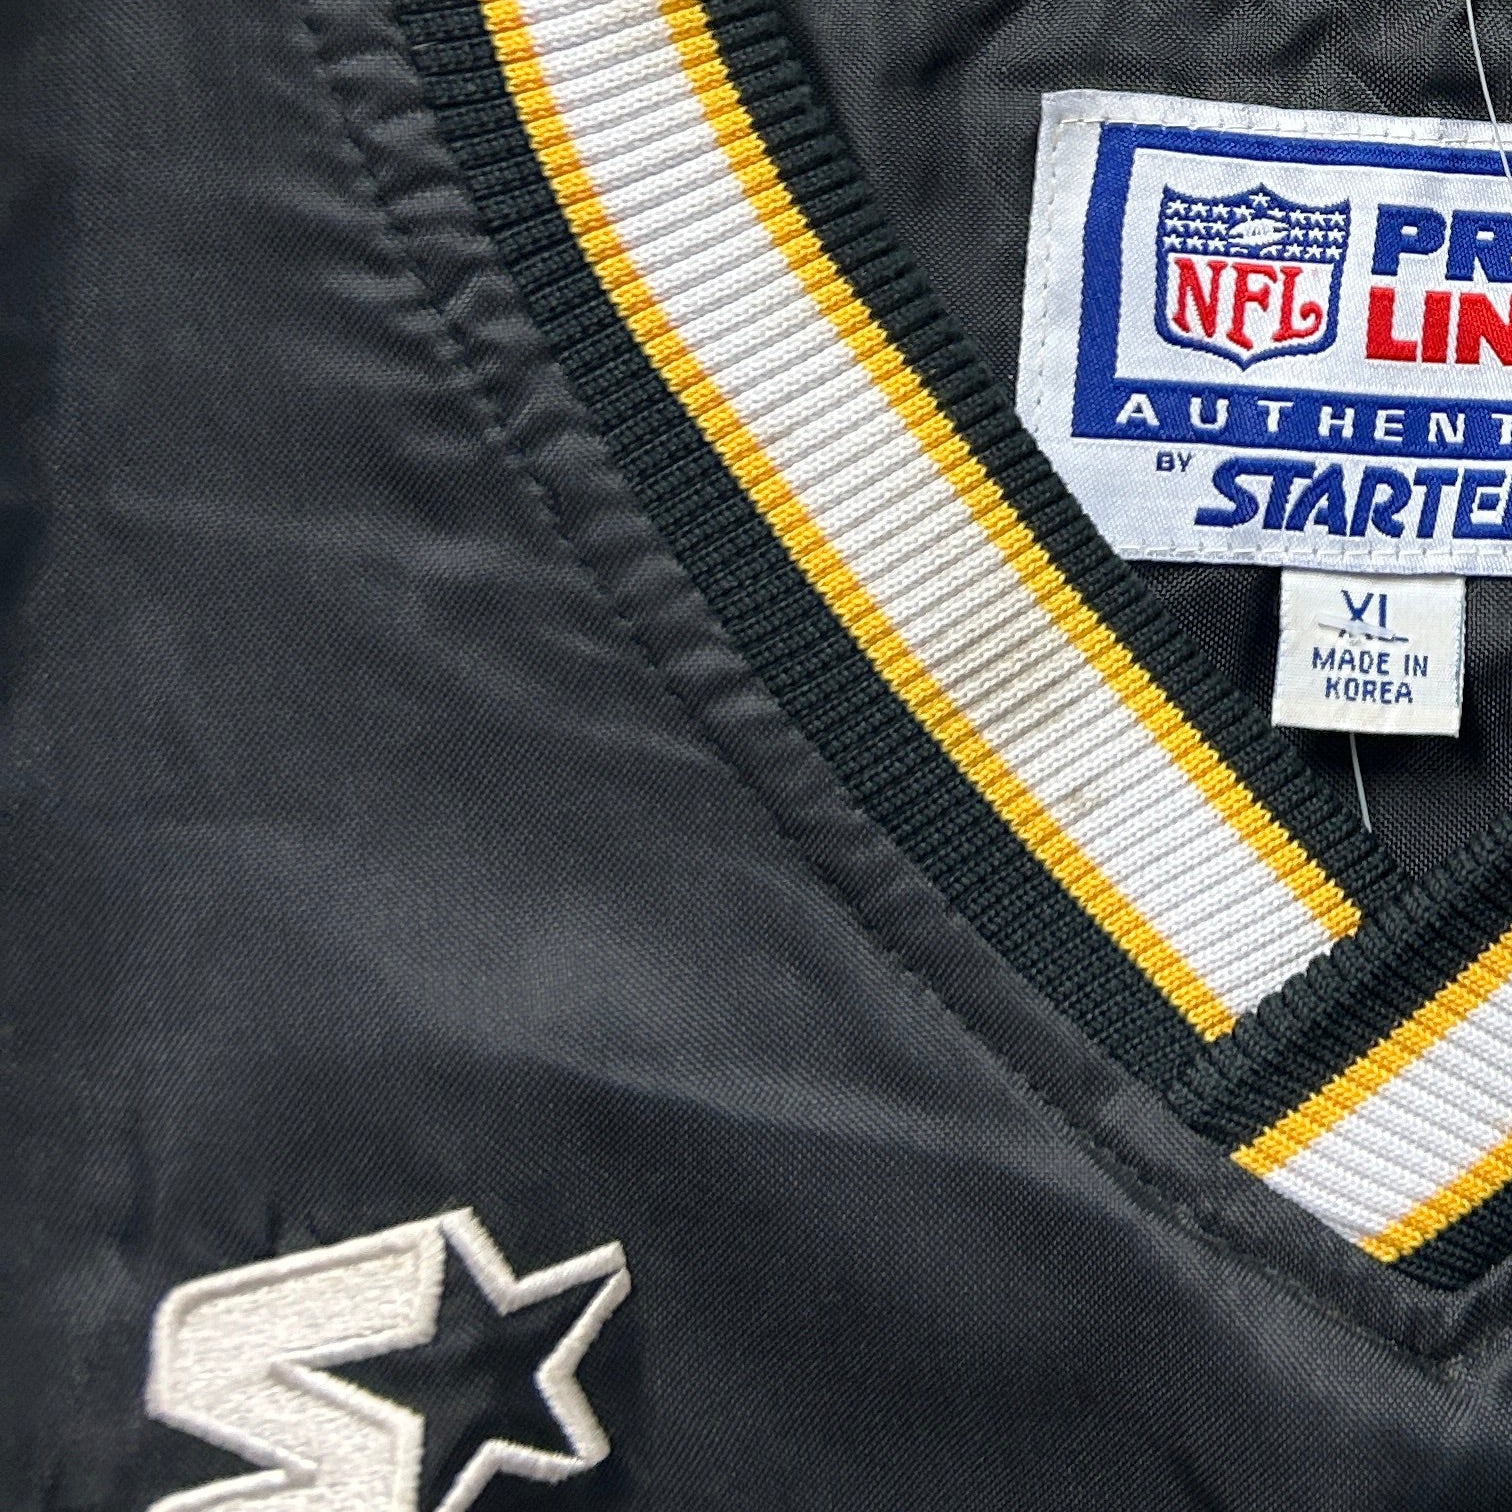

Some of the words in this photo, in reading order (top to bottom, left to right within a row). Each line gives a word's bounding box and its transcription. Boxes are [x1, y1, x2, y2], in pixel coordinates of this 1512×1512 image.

[1172, 256, 1323, 351] NFL
[1155, 451, 1192, 473] BY
[1311, 646, 1391, 675] MADE
[1403, 653, 1429, 678] IN
[1324, 676, 1414, 705] KOREA
